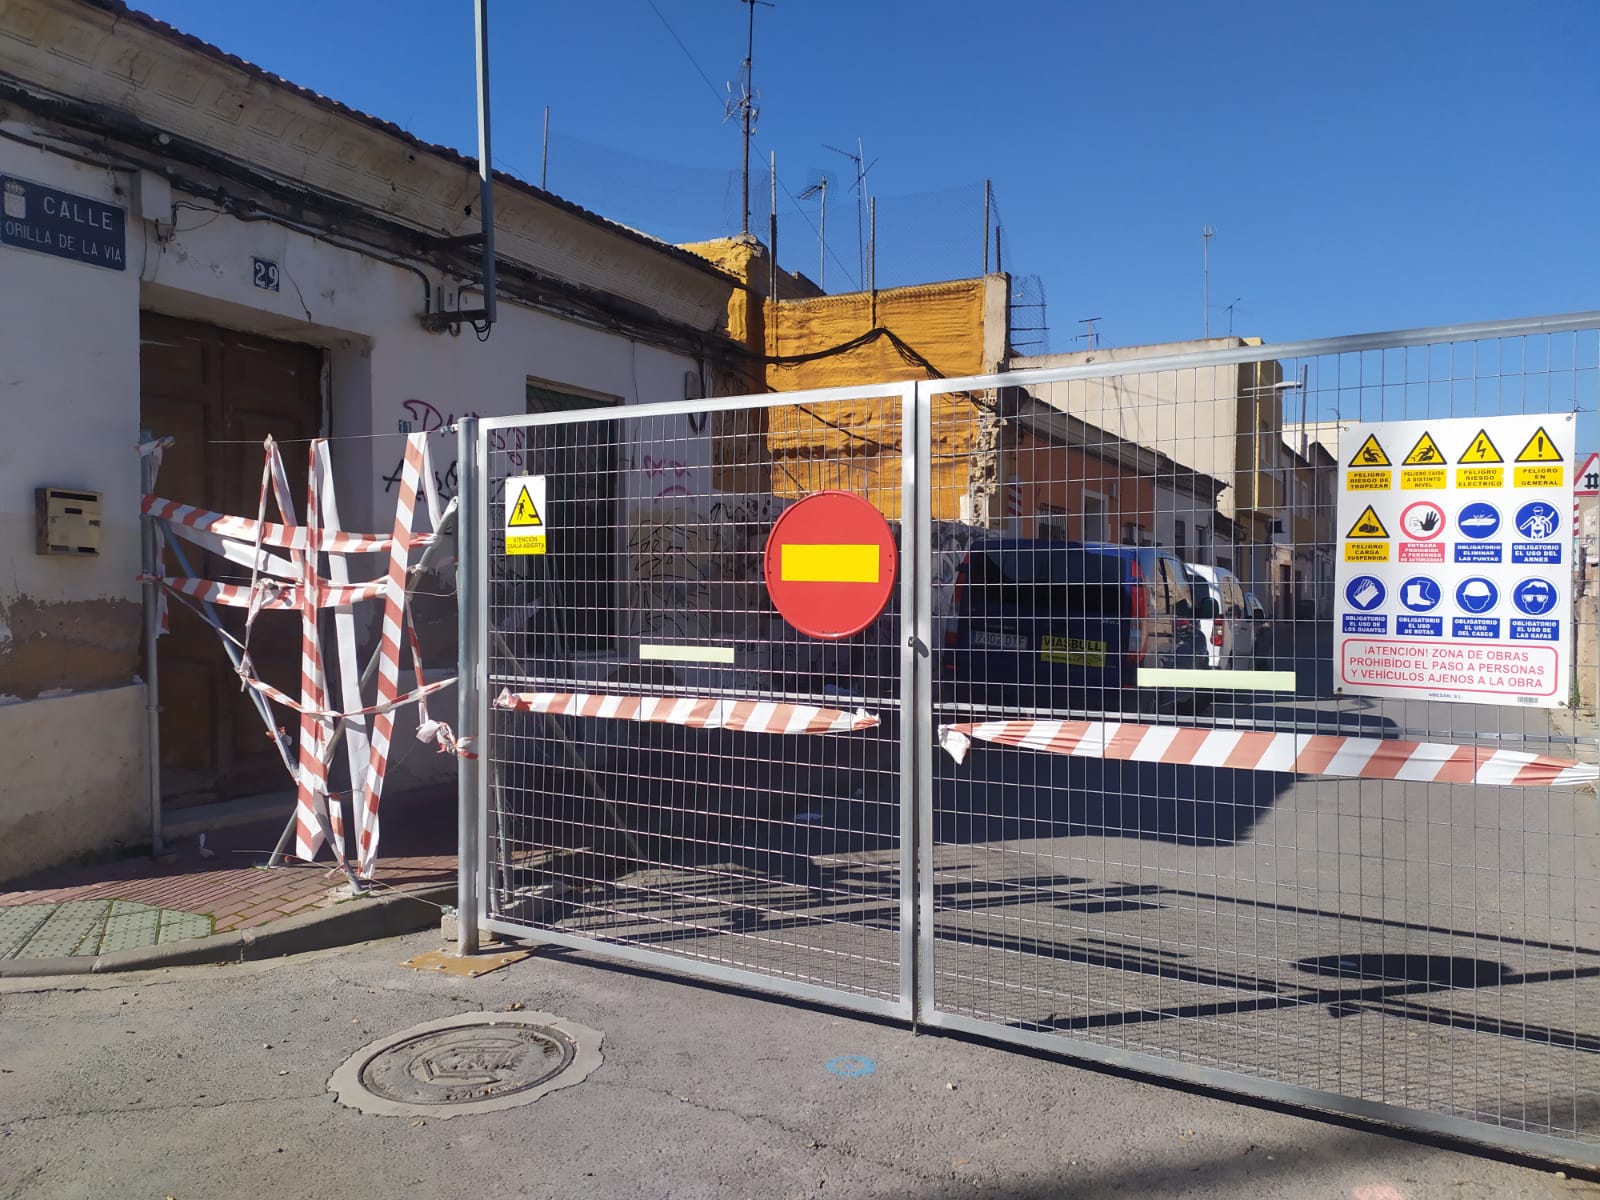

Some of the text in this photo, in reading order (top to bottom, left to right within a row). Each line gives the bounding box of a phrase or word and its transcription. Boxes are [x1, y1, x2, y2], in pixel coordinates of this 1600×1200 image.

[44, 196, 113, 231] CALLE
[6, 221, 122, 263] ORILLA DE LA VIA
[255, 262, 279, 288] 29
[1043, 636, 1102, 651] VIASBULL
[1432, 648, 1464, 659] ZONA
[1467, 650, 1483, 660] DE
[1486, 651, 1529, 662] OBRAS
[1414, 660, 1429, 670] EL
[1432, 661, 1464, 671] PASO
[1467, 663, 1475, 672] A
[1478, 663, 1545, 675] PERSONAS
[1351, 669, 1543, 688] Y VEHÍCULOS AJENOS A LA OBRA
